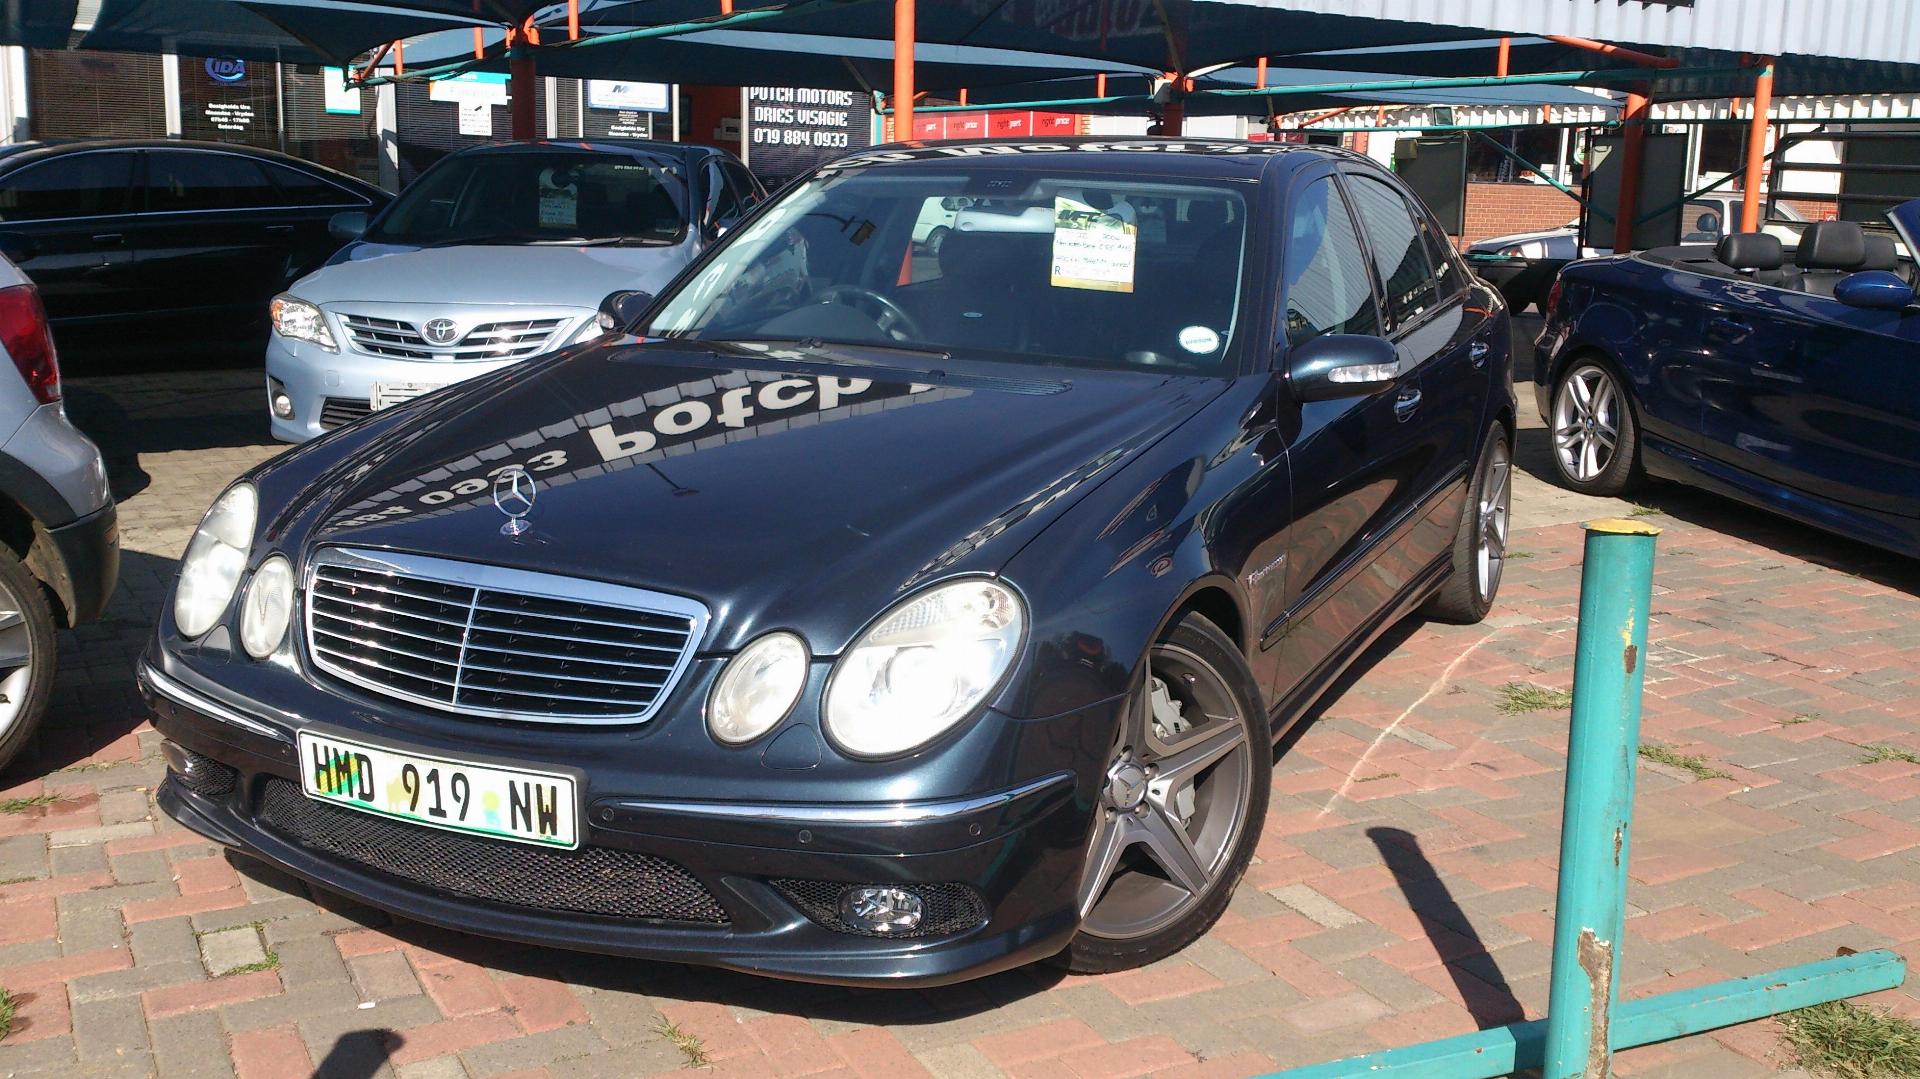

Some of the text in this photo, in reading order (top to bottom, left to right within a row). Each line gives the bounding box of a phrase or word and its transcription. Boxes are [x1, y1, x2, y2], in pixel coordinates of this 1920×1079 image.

[797, 88, 853, 106] MOTORS
[754, 107, 848, 127] DRIES VISAGIE
[754, 128, 849, 148] 079 884 0933
[1055, 265, 1062, 276] R
[312, 743, 558, 836] HMD 919 NW
